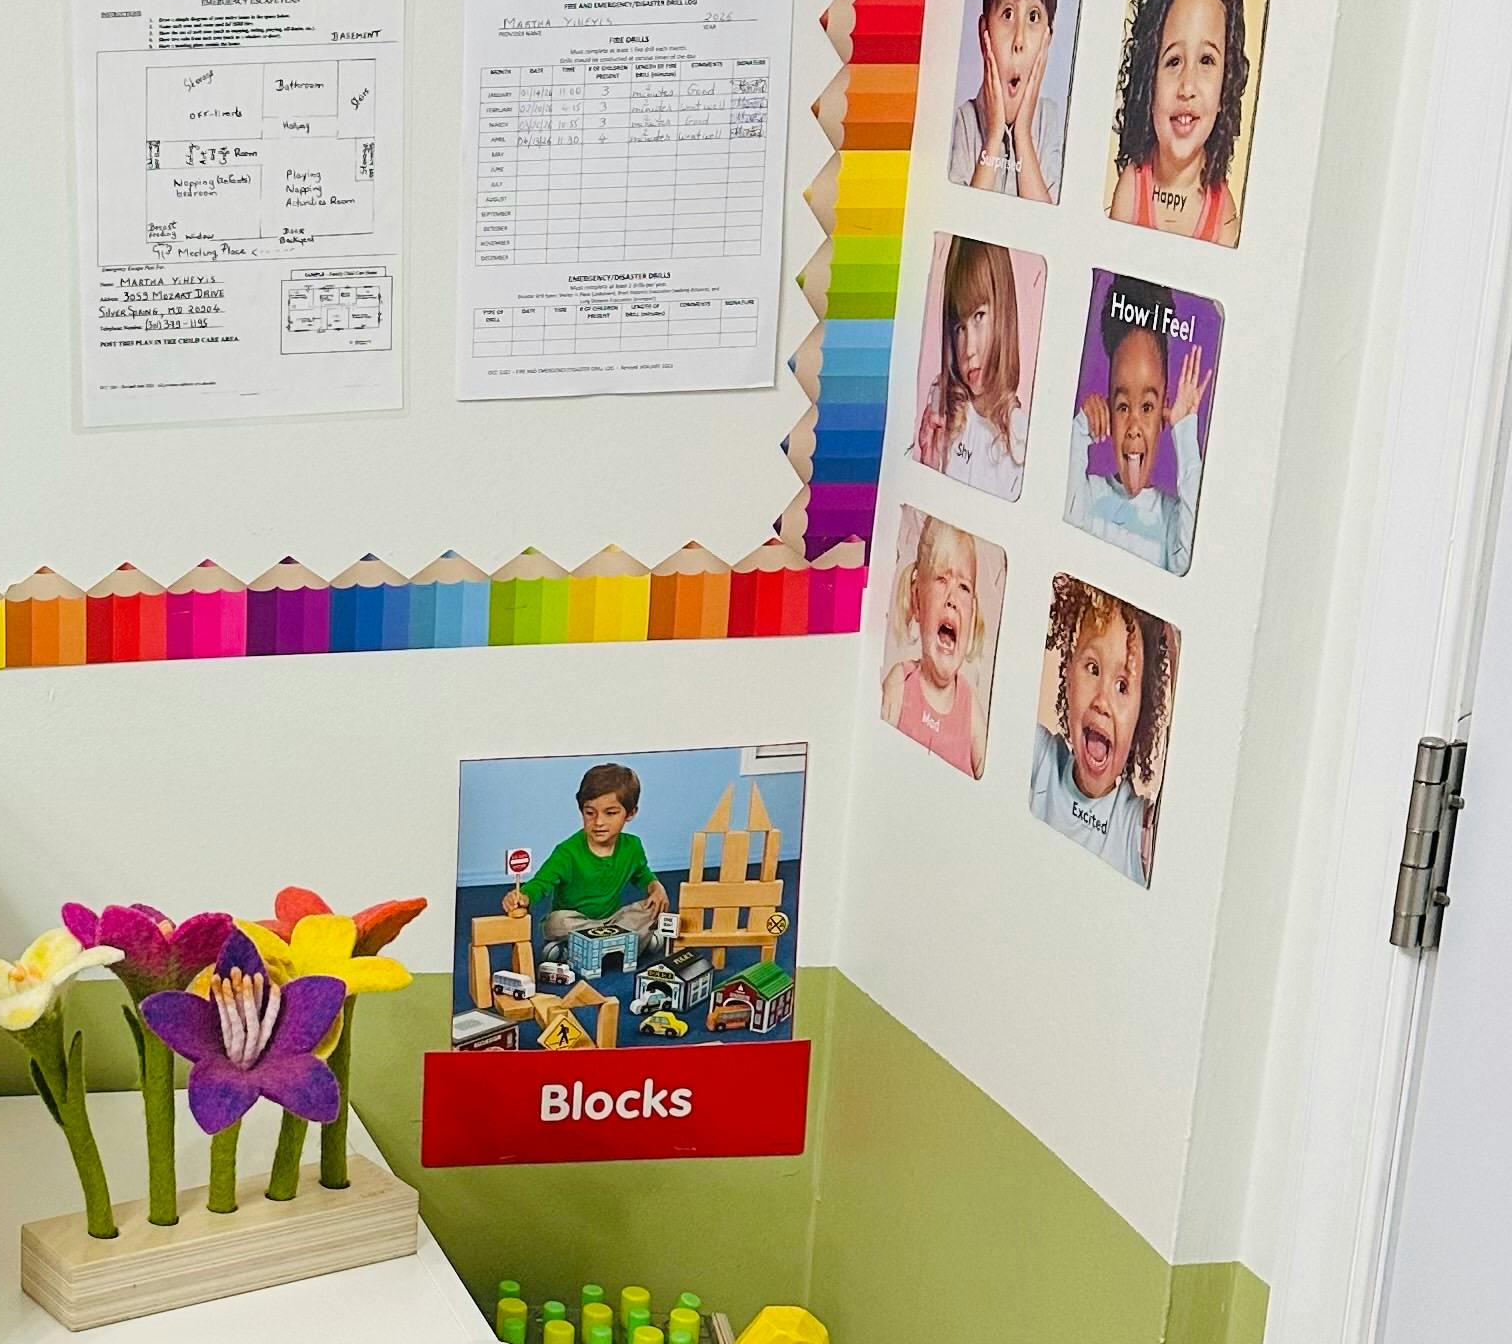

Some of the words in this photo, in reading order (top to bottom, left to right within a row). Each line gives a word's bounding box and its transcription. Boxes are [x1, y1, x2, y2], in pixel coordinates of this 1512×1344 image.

[331, 30, 382, 42] BASEMENT
[275, 79, 324, 92] Bathroom
[234, 148, 258, 157] Room
[286, 170, 321, 182] Playing
[173, 178, 215, 190] Napping
[176, 189, 218, 198] bedroom
[286, 184, 322, 197] Napping
[330, 197, 355, 205] Room
[1152, 187, 1188, 213] Happy
[120, 277, 164, 286] MARTHA
[195, 288, 225, 299] DRIVE
[1111, 292, 1149, 328] How
[1153, 304, 1160, 331] I
[1161, 307, 1196, 343] Feel
[956, 442, 972, 464] Shy
[922, 710, 941, 733] Mad
[1072, 801, 1108, 835] Excited
[541, 1078, 693, 1121] Blocks
